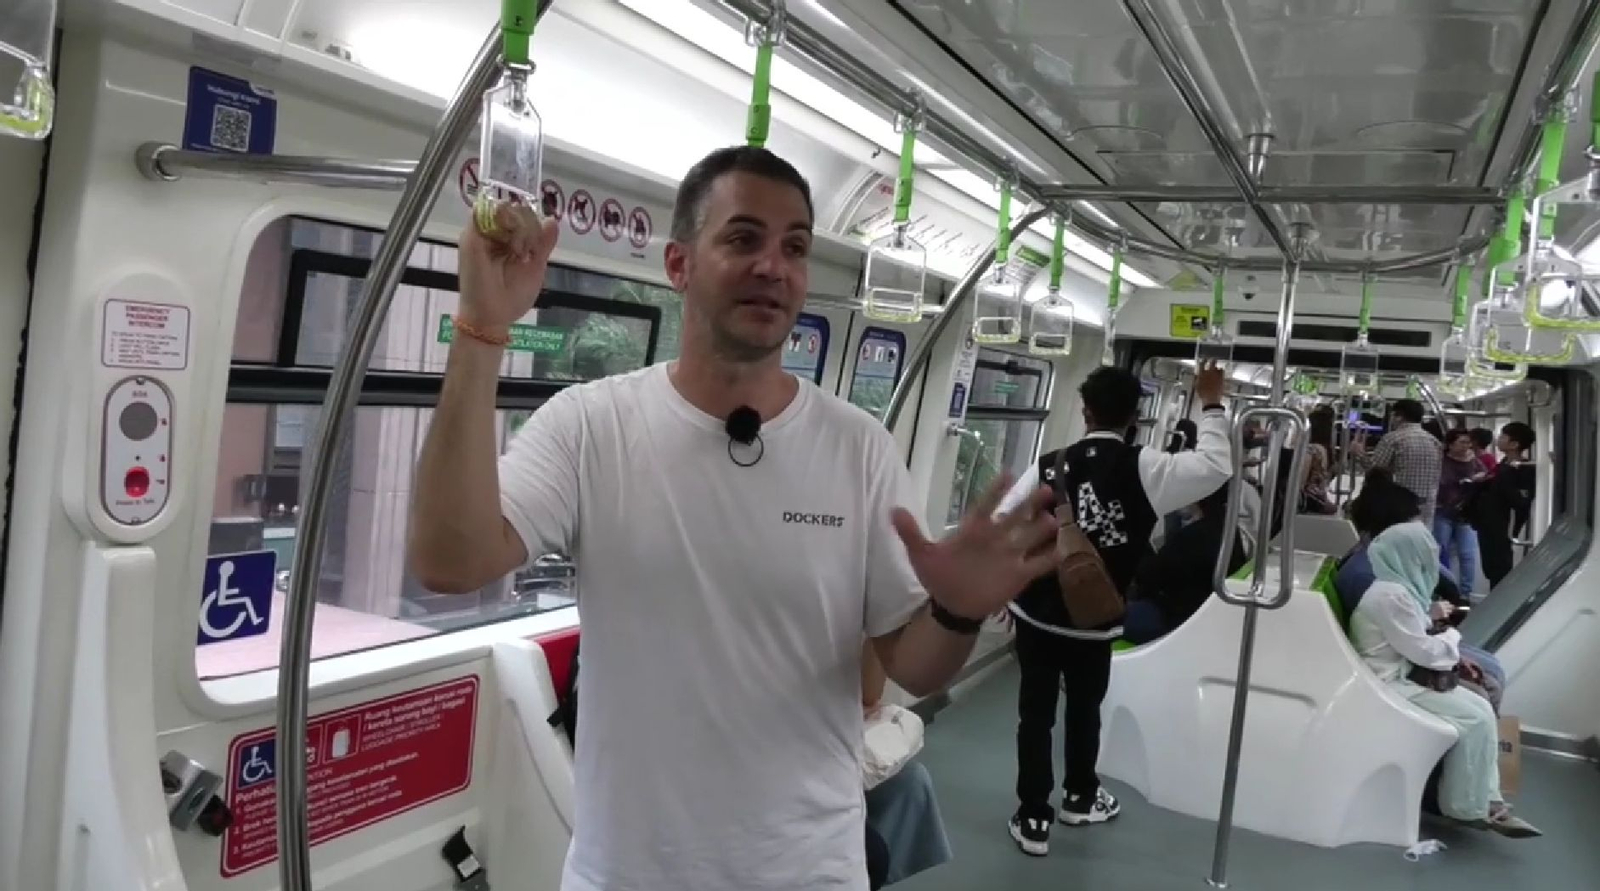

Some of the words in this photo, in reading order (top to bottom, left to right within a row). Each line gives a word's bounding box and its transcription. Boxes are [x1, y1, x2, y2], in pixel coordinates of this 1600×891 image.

[126, 305, 170, 314] EMERGENCY
[126, 313, 168, 322] PASSENGER
[128, 320, 165, 329] INTERCOM
[782, 511, 845, 528] DOCKERS
